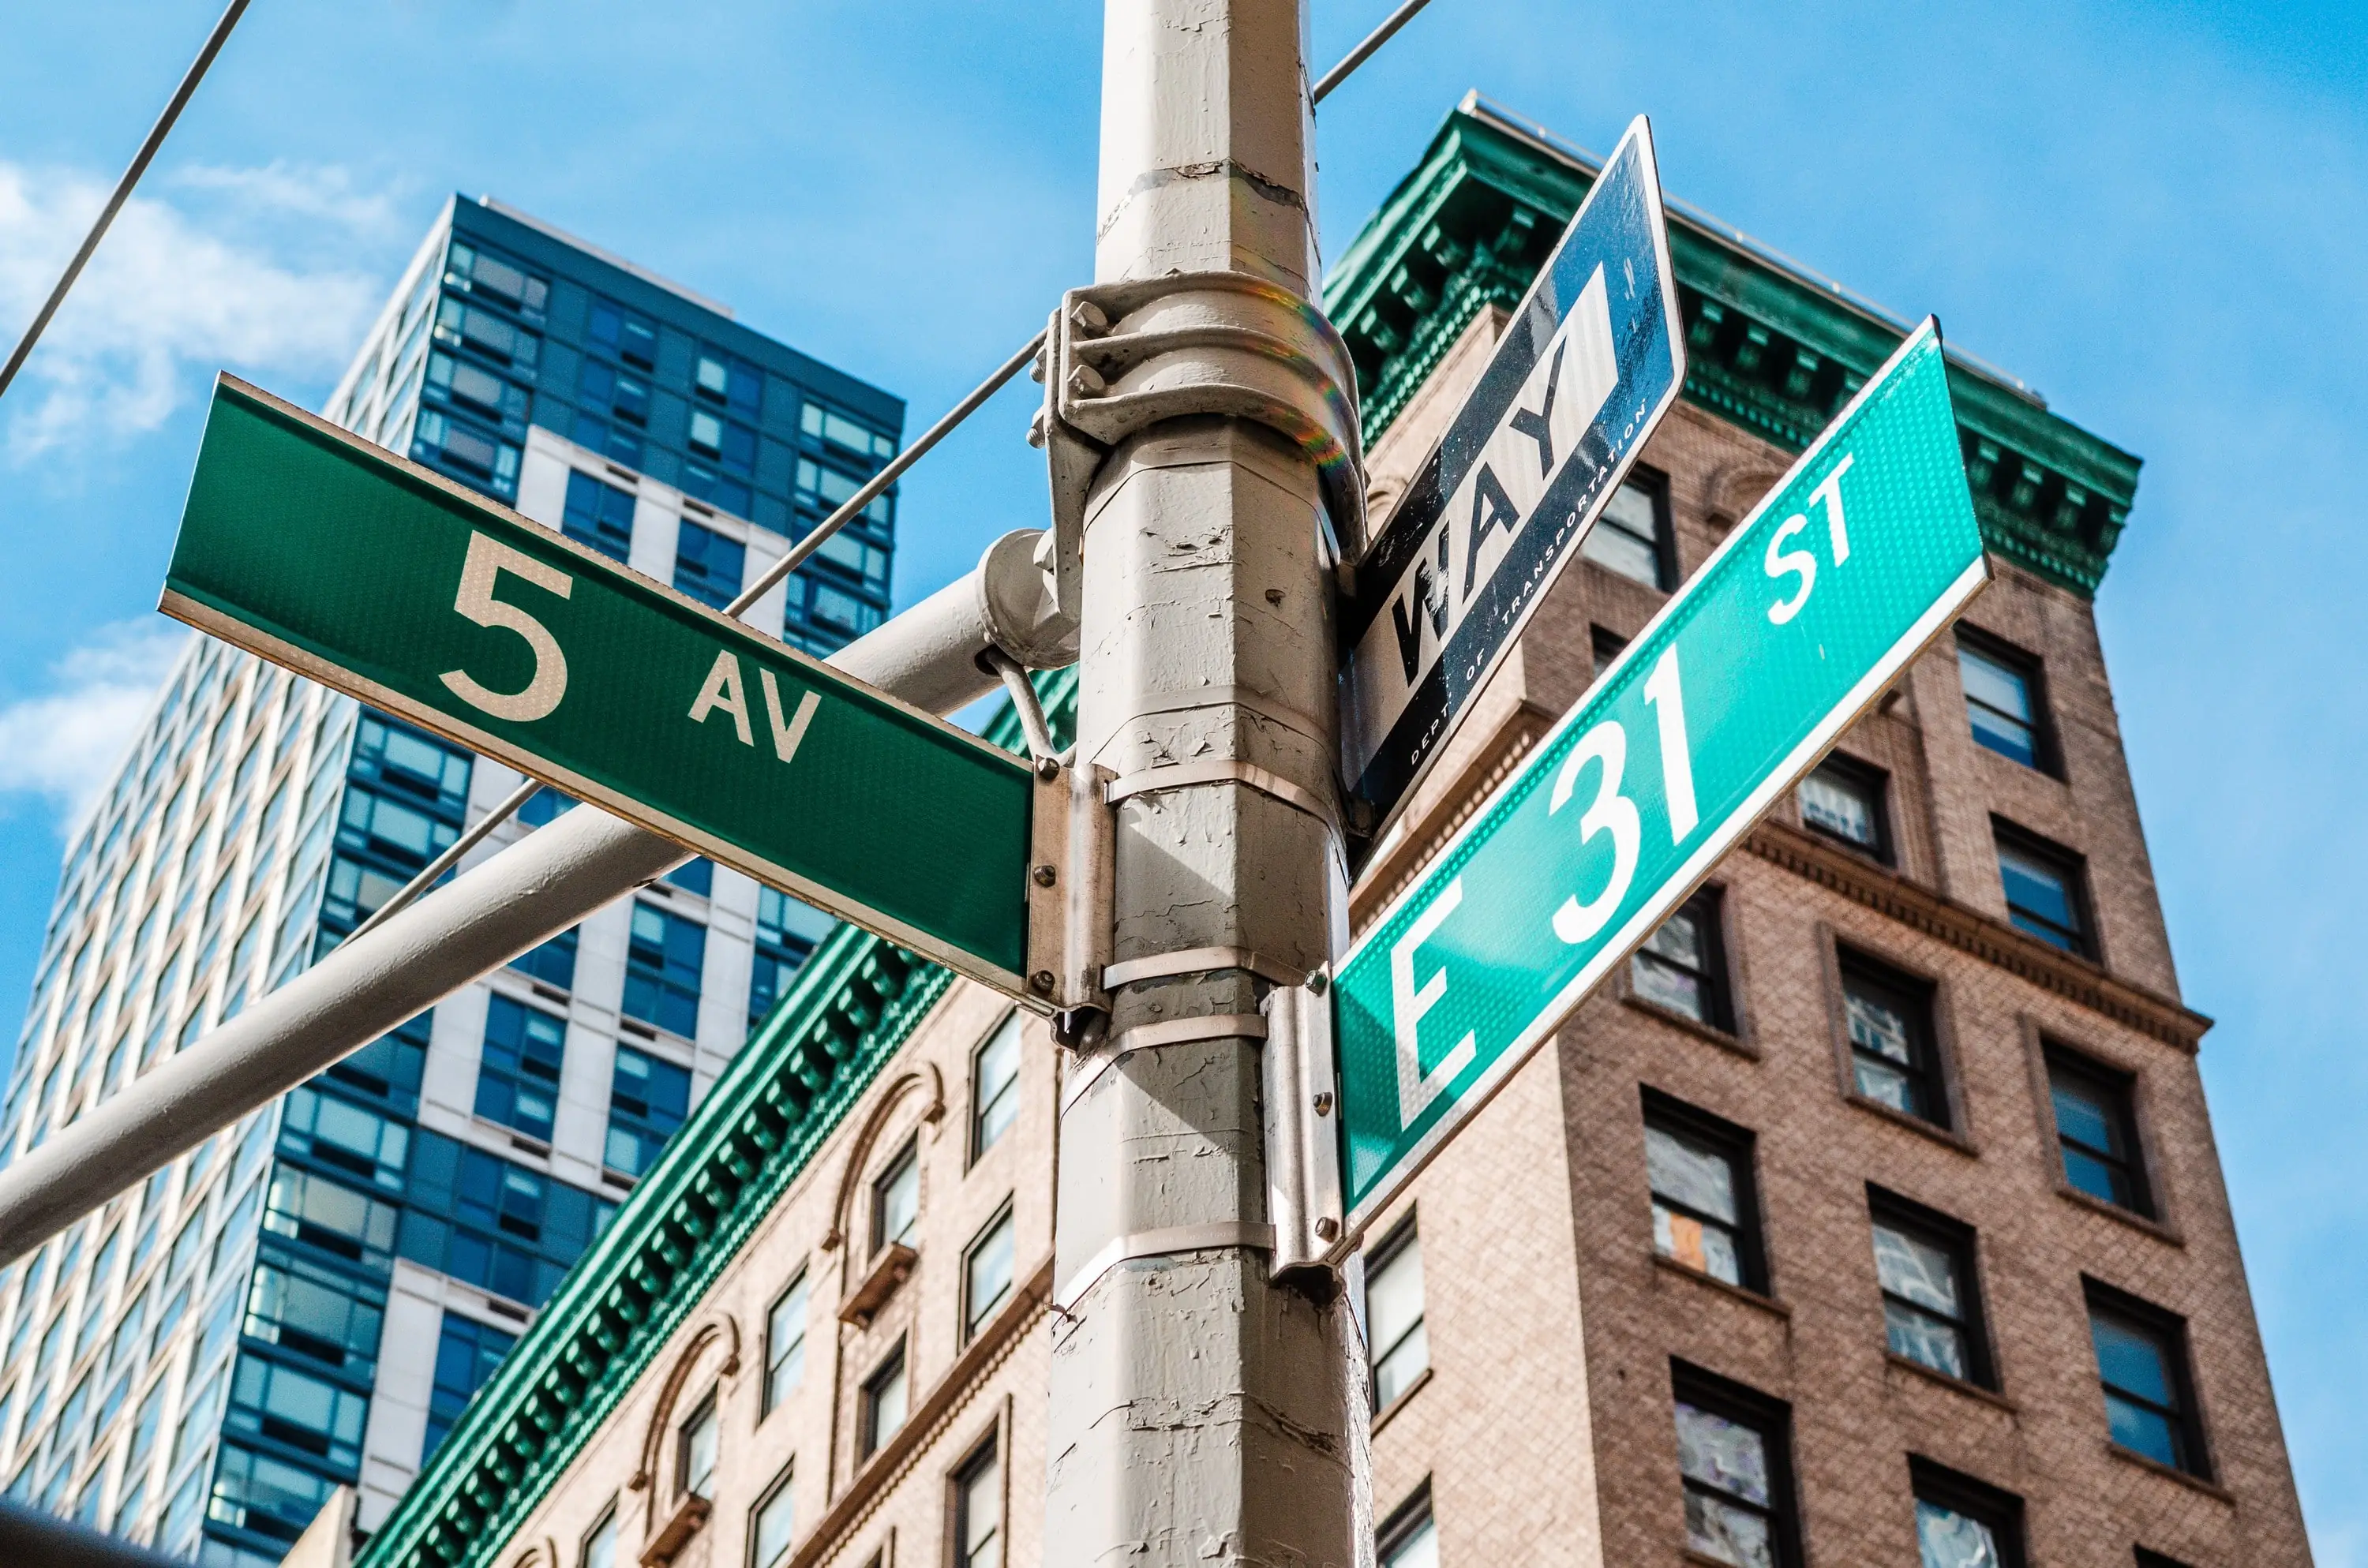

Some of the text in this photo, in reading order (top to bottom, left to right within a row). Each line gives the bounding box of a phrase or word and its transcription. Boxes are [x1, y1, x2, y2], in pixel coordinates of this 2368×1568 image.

[439, 530, 822, 765] 5 AV
[1392, 335, 1568, 688] WAY
[1466, 648, 1485, 681] OF
[1501, 403, 1646, 626] TRANSPORTATION
[1391, 452, 1854, 1132] E 31 ST
